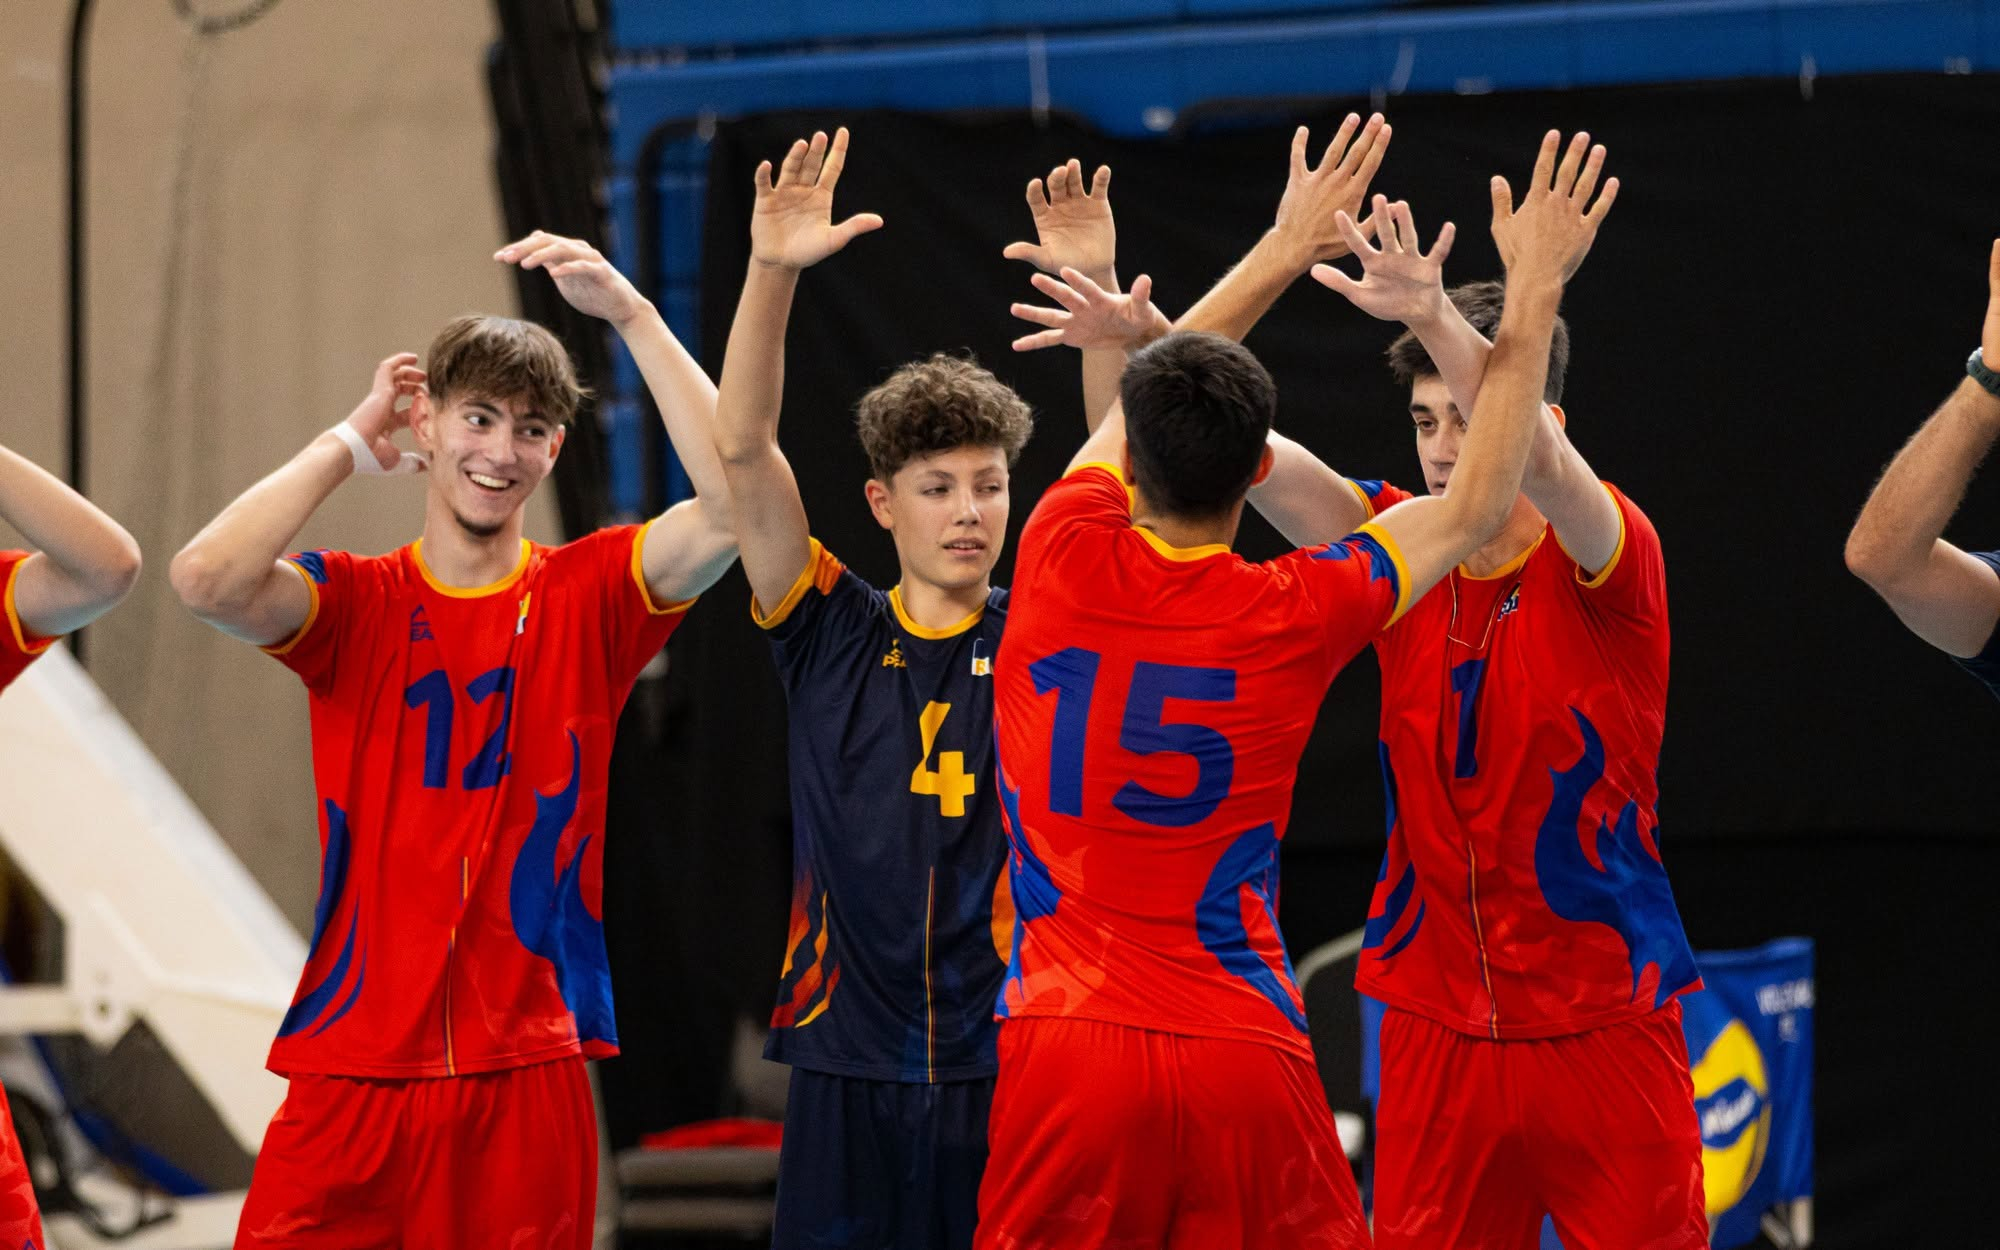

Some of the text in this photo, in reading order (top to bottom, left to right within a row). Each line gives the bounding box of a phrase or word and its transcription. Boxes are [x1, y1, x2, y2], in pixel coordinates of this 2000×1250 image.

[410, 628, 434, 642] EA
[404, 667, 516, 790] 12
[910, 700, 975, 818] 4
[1028, 646, 1236, 827] 15
[1451, 657, 1486, 779] 1
